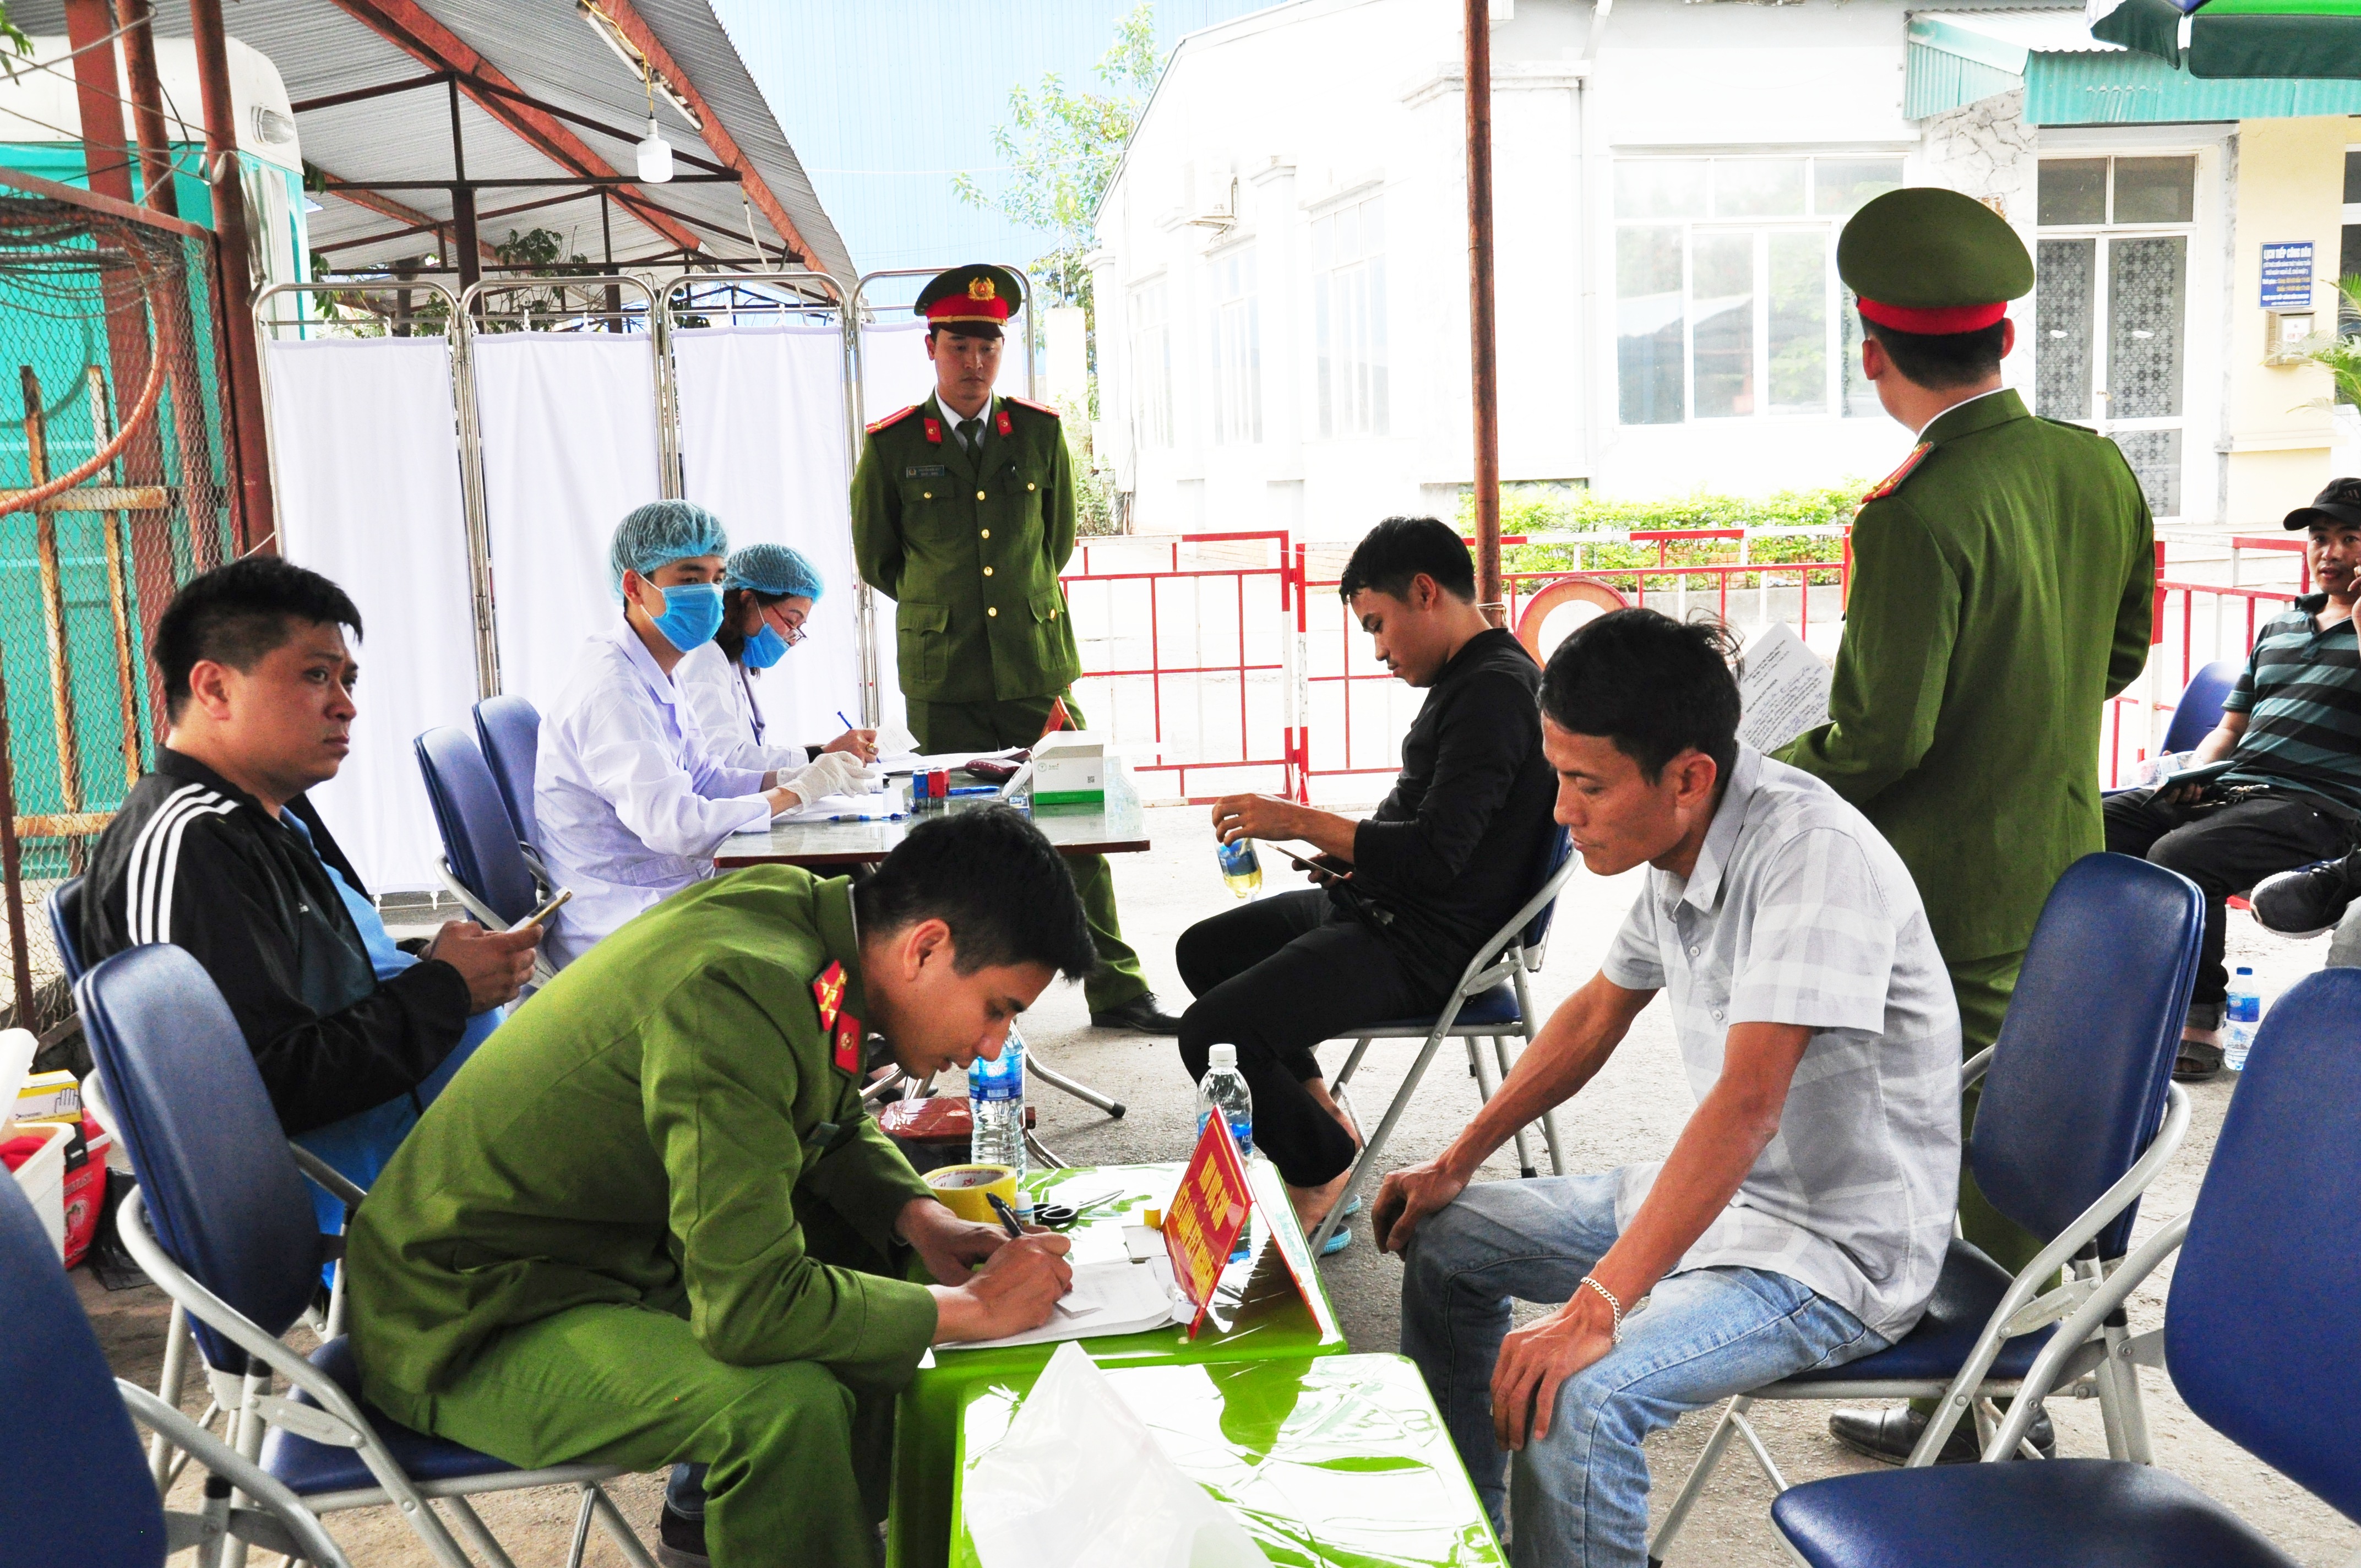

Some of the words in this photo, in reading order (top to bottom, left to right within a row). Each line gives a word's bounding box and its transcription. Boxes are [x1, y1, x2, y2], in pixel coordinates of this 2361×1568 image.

[1199, 1151, 1217, 1194] KHU
[1204, 1168, 1223, 1213] VỰC
[1172, 1180, 1193, 1222] KẾT
[1184, 1221, 1204, 1263] XÉT
[1211, 1188, 1233, 1232] CHỜ
